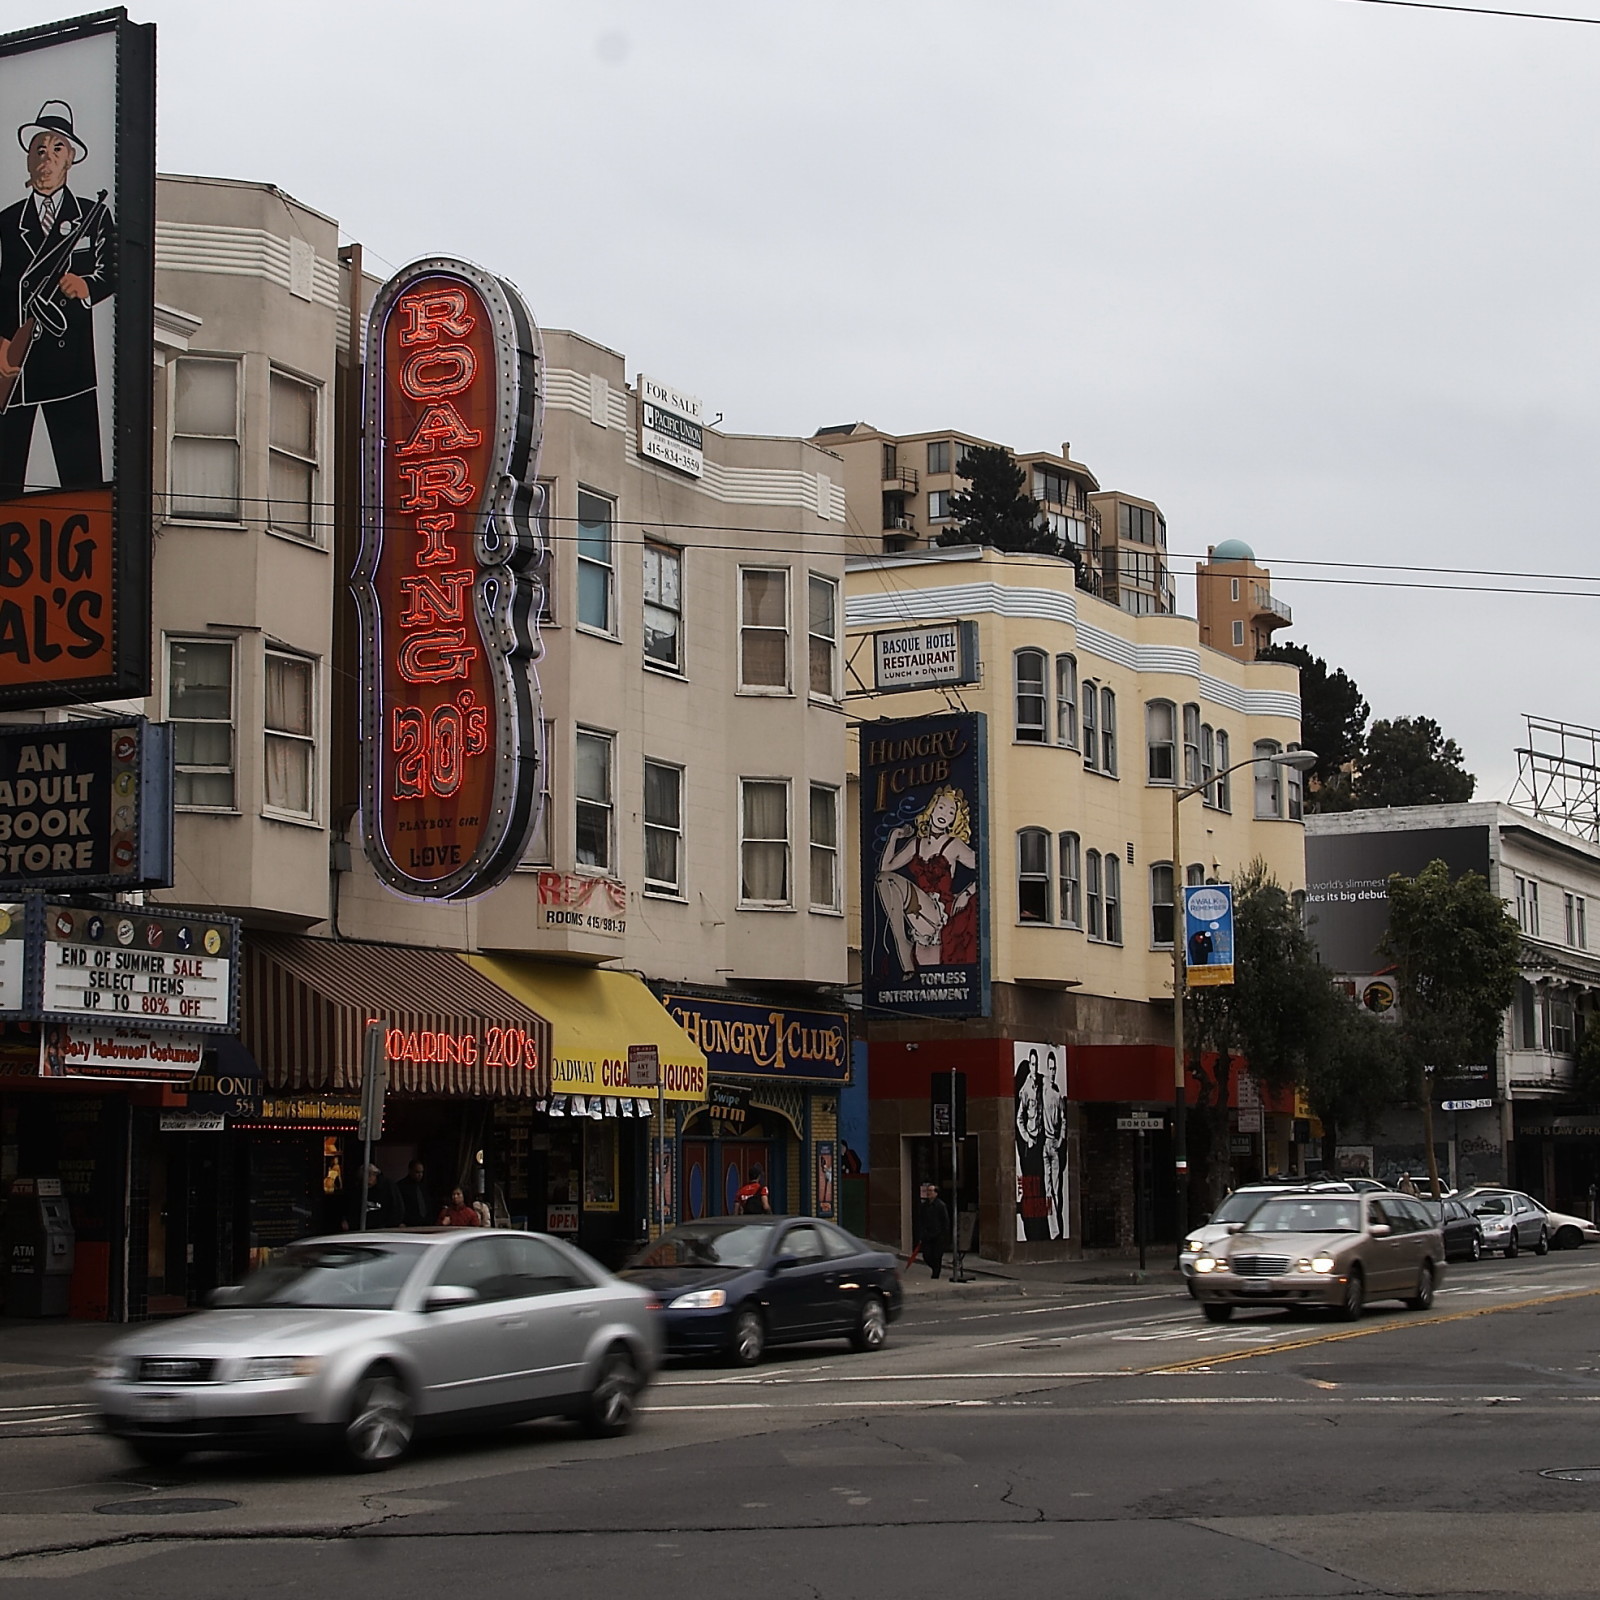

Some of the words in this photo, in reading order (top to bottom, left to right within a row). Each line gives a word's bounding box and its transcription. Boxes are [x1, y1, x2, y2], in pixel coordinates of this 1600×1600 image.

[646, 382, 668, 403] FOR
[671, 394, 699, 417] SALE
[655, 409, 679, 433] PACIFIC
[680, 420, 702, 444] UNION
[647, 441, 700, 472] 415-834-3559
[395, 288, 482, 680] ROARING
[0, 514, 97, 588] BIG
[0, 588, 105, 664] AL'S
[883, 637, 920, 655] BASQUE
[926, 633, 956, 650] HOTEL
[884, 650, 957, 670] RESTAURANT
[885, 671, 912, 680] LUNCH
[922, 665, 955, 675] DINNER
[17, 743, 66, 773] AN
[868, 729, 967, 767] HUNGRY
[0, 773, 95, 807] ADULT
[874, 770, 888, 812] I
[890, 760, 949, 793] CLUB
[0, 807, 91, 840] BOOK
[399, 818, 453, 831] PLAYBOY
[458, 816, 479, 827] GIRL
[0, 840, 95, 873] STORE
[410, 845, 461, 867] LOVE
[1305, 890, 1326, 903] akes
[1327, 892, 1339, 902] its
[1340, 890, 1357, 903] big
[1313, 879, 1344, 890] world's
[1345, 879, 1385, 888] slimmest
[546, 910, 583, 926] ROOMS
[62, 947, 87, 965] END
[94, 952, 111, 967] OF
[115, 952, 165, 974] SUMMER
[173, 958, 203, 977] SALE
[89, 971, 135, 990] SELECT
[149, 978, 184, 995] ITEMS
[920, 971, 967, 986] TOPLESS
[84, 991, 101, 1009] UP
[113, 994, 130, 1010] TO
[141, 996, 169, 1014] 80%
[179, 999, 201, 1015] OFF
[878, 987, 970, 1003] ENTERTAINMENT
[93, 1037, 147, 1060] Halloween
[367, 1018, 478, 1066] OARING
[486, 1026, 538, 1070] 20's
[674, 1008, 770, 1062] HUNGRY
[769, 1012, 785, 1068] I
[786, 1022, 845, 1066] CLUB
[552, 1058, 596, 1083] OADWAY
[661, 1064, 704, 1093] IQUORS
[713, 1090, 740, 1105] Swipe
[710, 1105, 745, 1122] ATM
[1520, 1127, 1541, 1135] PIER
[1553, 1126, 1573, 1136] LAW
[549, 1214, 577, 1228] OPEN
[12, 1245, 35, 1257] ATM
